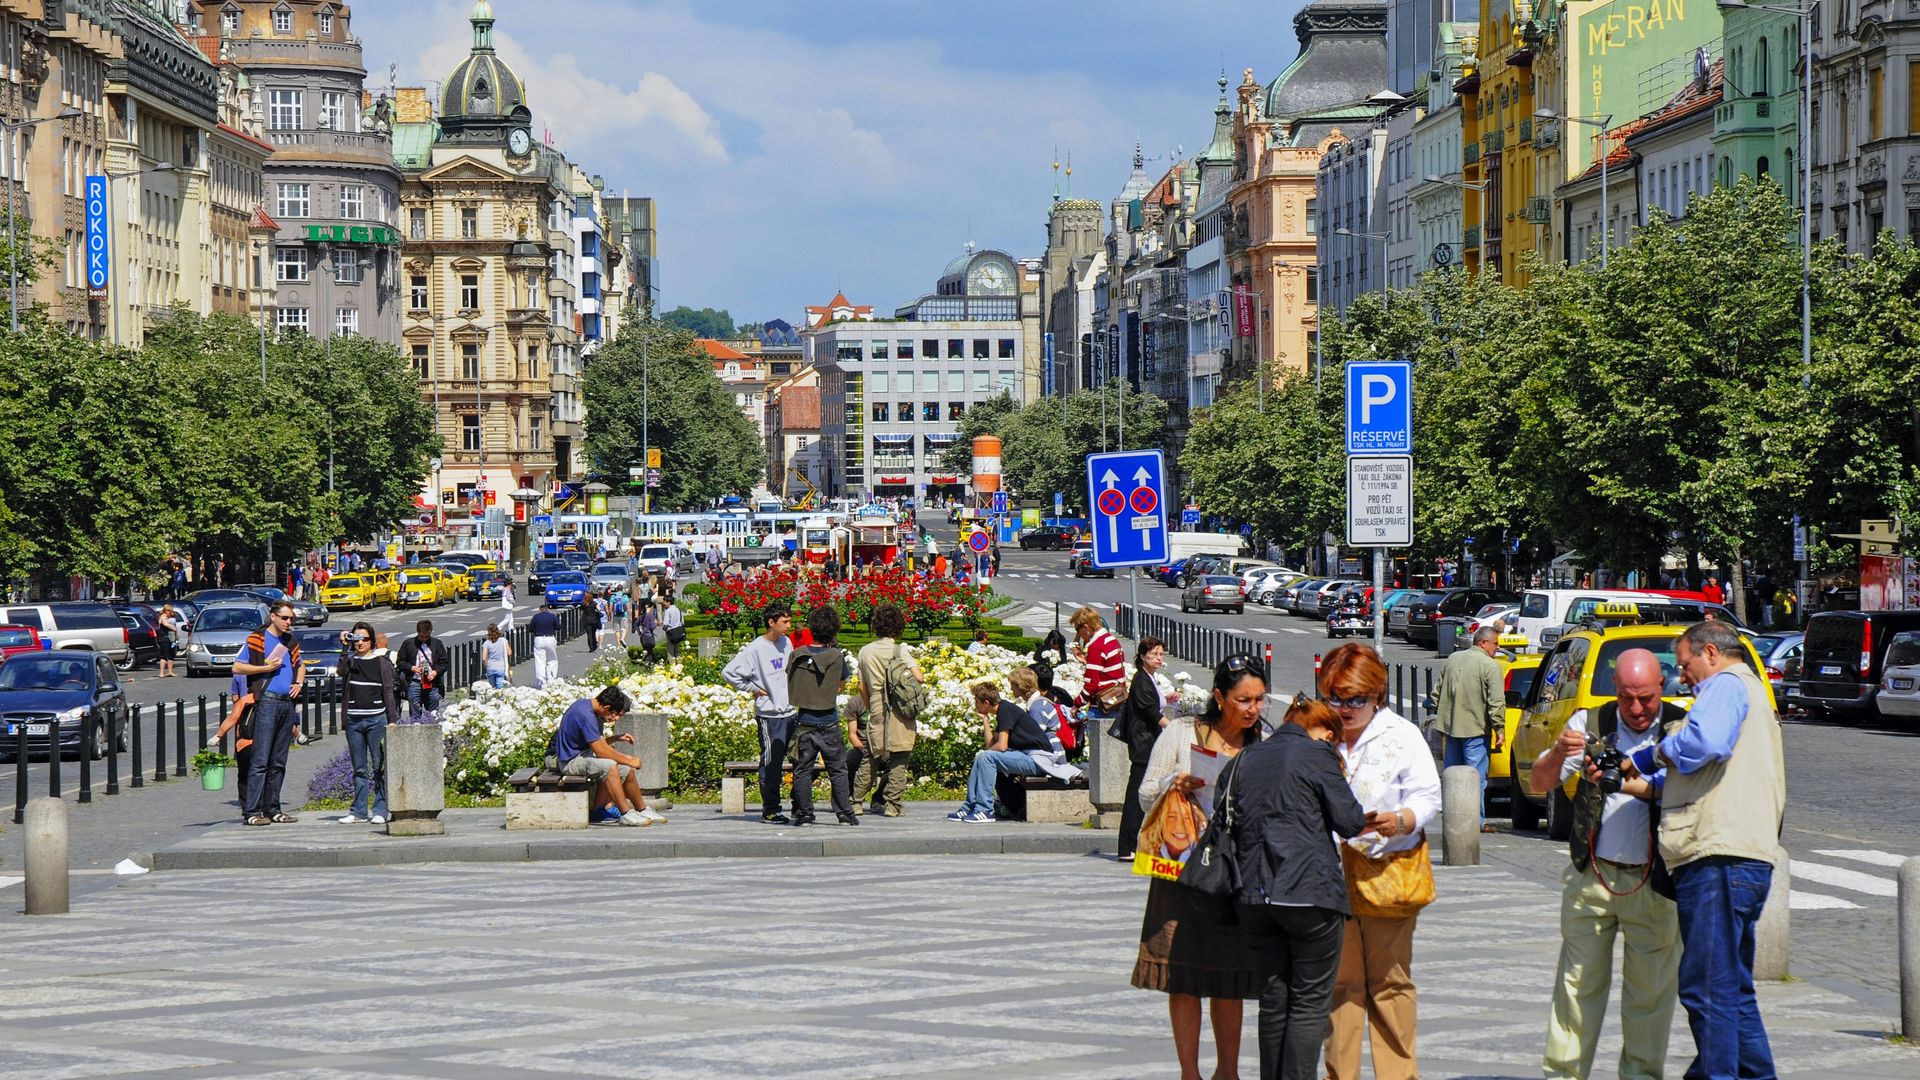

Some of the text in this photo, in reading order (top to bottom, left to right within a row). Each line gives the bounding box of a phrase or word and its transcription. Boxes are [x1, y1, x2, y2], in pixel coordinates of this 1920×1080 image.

[1588, 0, 1686, 56] MERAN
[90, 182, 105, 286] ROKOKO
[304, 224, 400, 245] LIGNA
[89, 288, 107, 297] hotel
[1361, 374, 1397, 425] P
[1353, 429, 1406, 442] RÉSERVÉ
[1354, 463, 1406, 473] STANOVIŠTĚ VOZIDEL
[1383, 473, 1403, 481] ZÁKONA
[1368, 482, 1389, 490] 111/1994
[1368, 493, 1392, 504] PRO PĚT
[1366, 504, 1403, 515] VOZŮ TAXI SE
[1355, 516, 1406, 526] SOUHLASEM SPRÁVCE
[1375, 528, 1387, 537] TSK
[1602, 603, 1632, 613] TAXI
[770, 657, 783, 670] W
